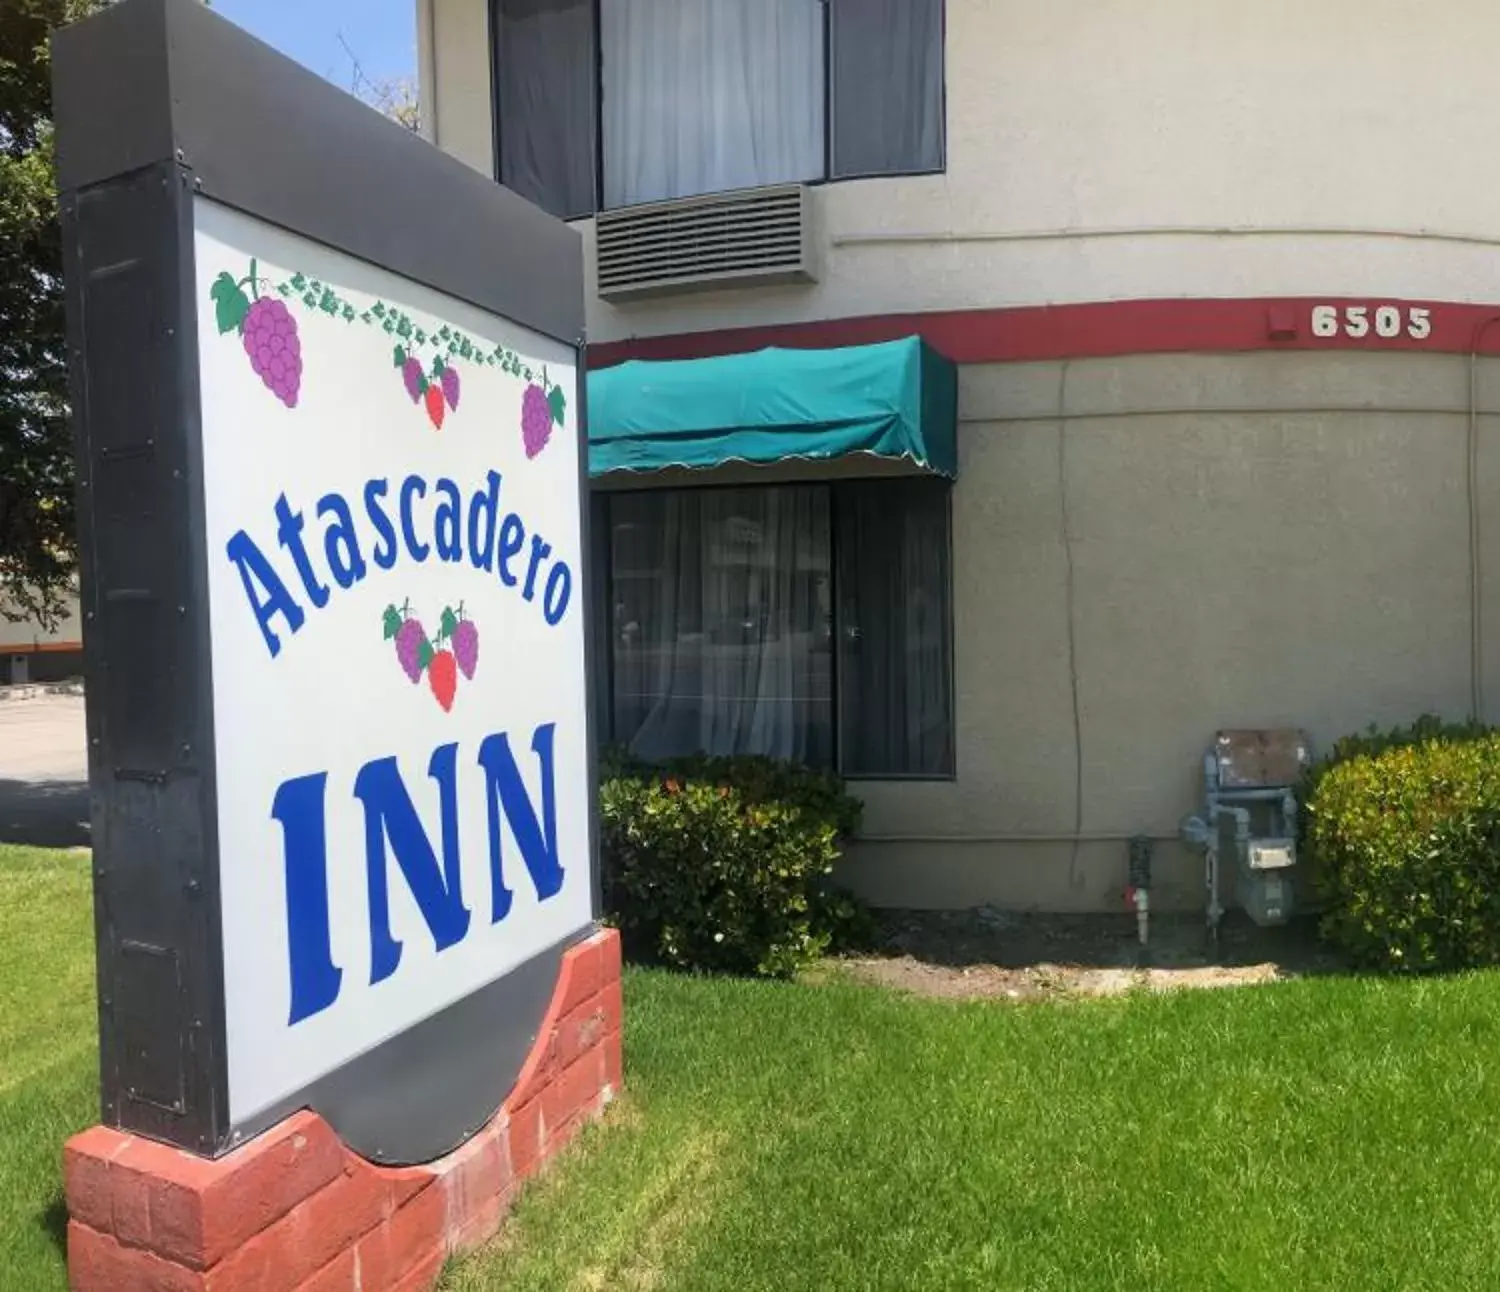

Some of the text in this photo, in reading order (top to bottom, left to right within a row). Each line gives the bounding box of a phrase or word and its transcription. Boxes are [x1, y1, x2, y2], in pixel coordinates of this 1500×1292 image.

[1311, 305, 1431, 339] 6505
[226, 469, 573, 658] Atascadero
[271, 722, 566, 1026] INN
